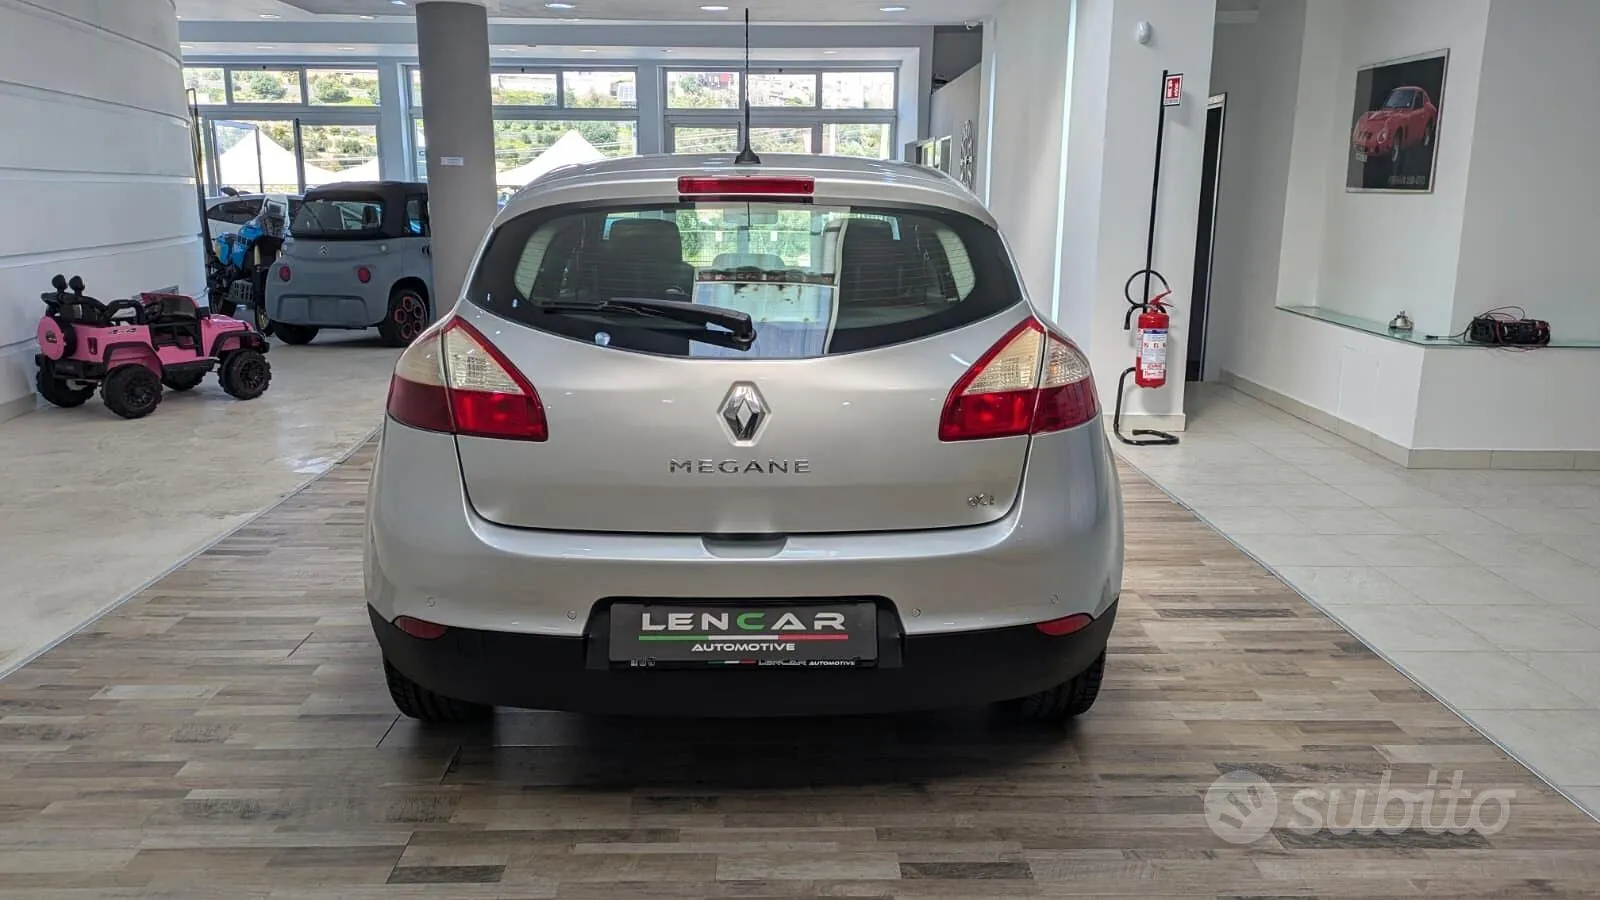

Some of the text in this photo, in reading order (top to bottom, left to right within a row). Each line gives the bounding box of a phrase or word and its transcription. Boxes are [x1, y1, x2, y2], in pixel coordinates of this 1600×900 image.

[669, 458, 811, 474] MEGANE
[641, 612, 846, 631] LENCAR
[691, 643, 796, 651] AUTOMOTIVE
